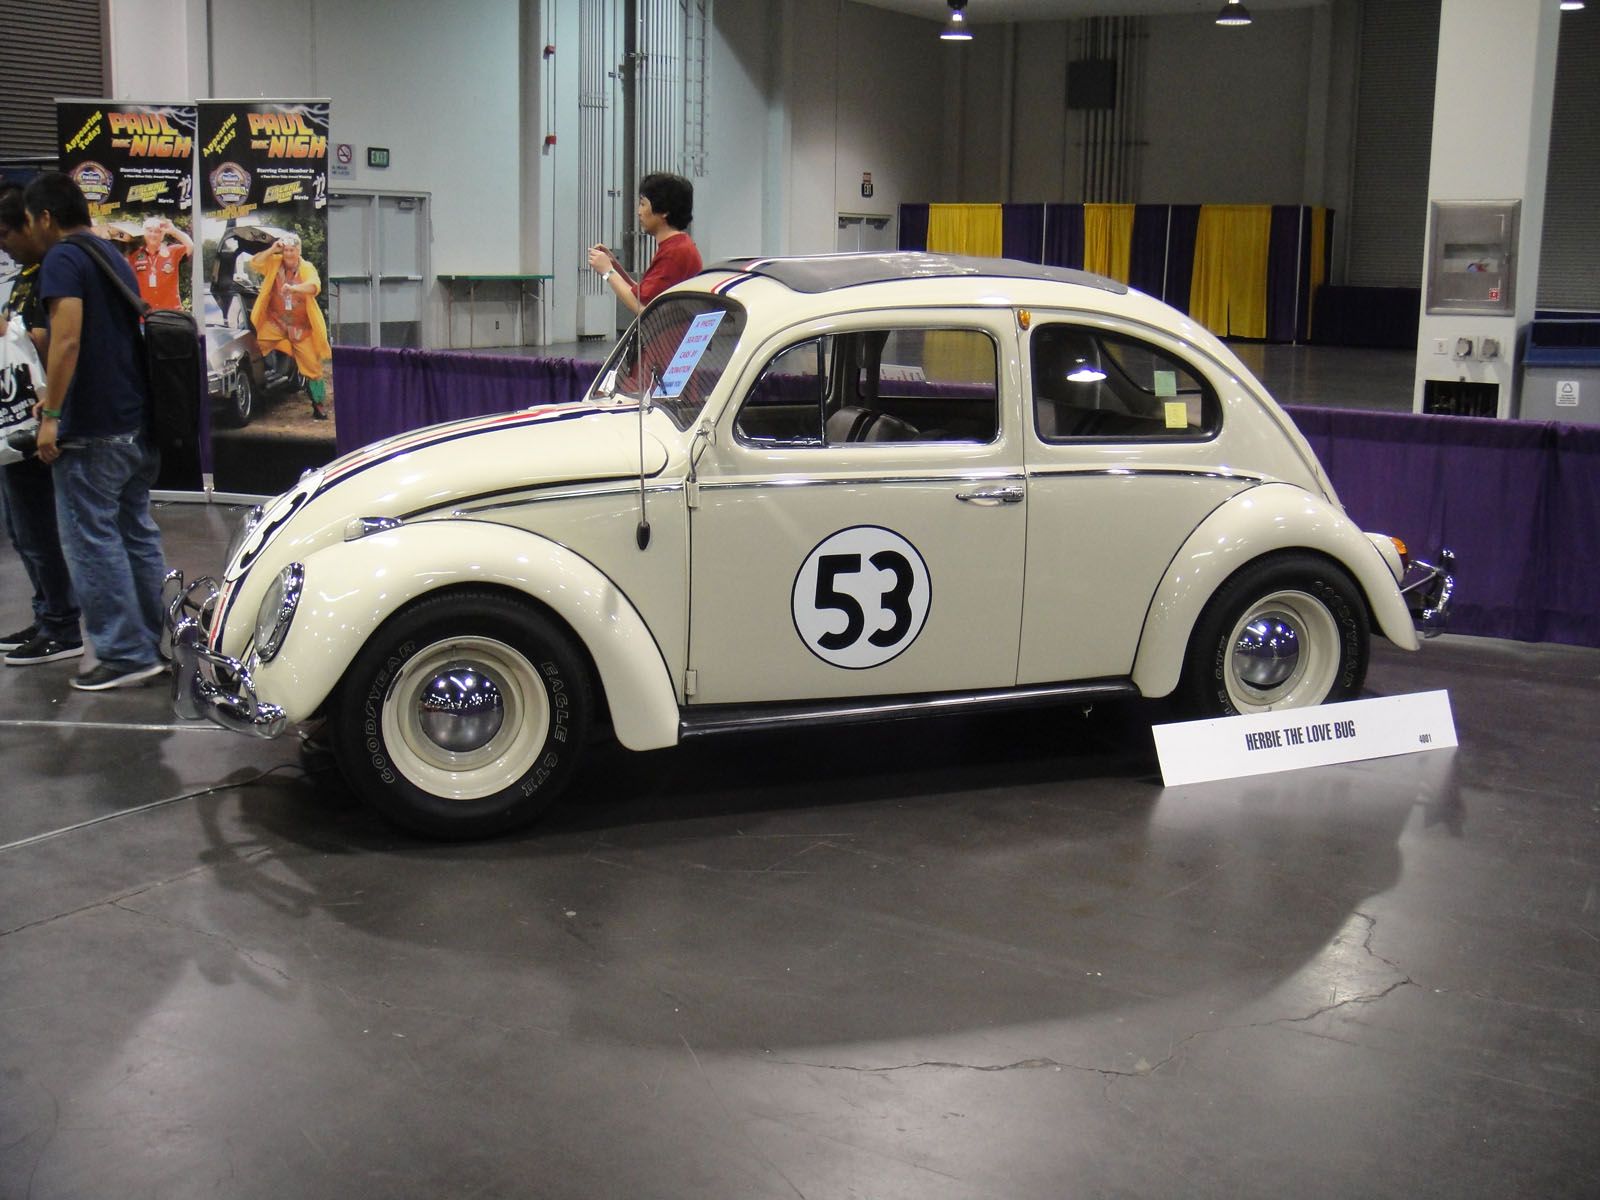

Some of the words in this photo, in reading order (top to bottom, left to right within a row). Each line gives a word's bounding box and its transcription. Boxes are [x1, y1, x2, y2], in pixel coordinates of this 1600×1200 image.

[65, 110, 102, 153] Appearing
[78, 124, 101, 150] Today
[108, 112, 178, 135] PAUL
[202, 113, 238, 158] Appearing
[247, 113, 314, 135] PAUL
[129, 135, 192, 158] NIGH
[215, 127, 237, 154] Today
[268, 135, 326, 158] NIGH
[814, 549, 915, 651] 53
[364, 640, 417, 784] GOODYEAR
[541, 662, 569, 743] EAGLE
[1245, 730, 1283, 751] HERBIE
[1283, 727, 1304, 746] THE
[1305, 723, 1332, 743] LOVE
[1334, 720, 1356, 739] BUG
